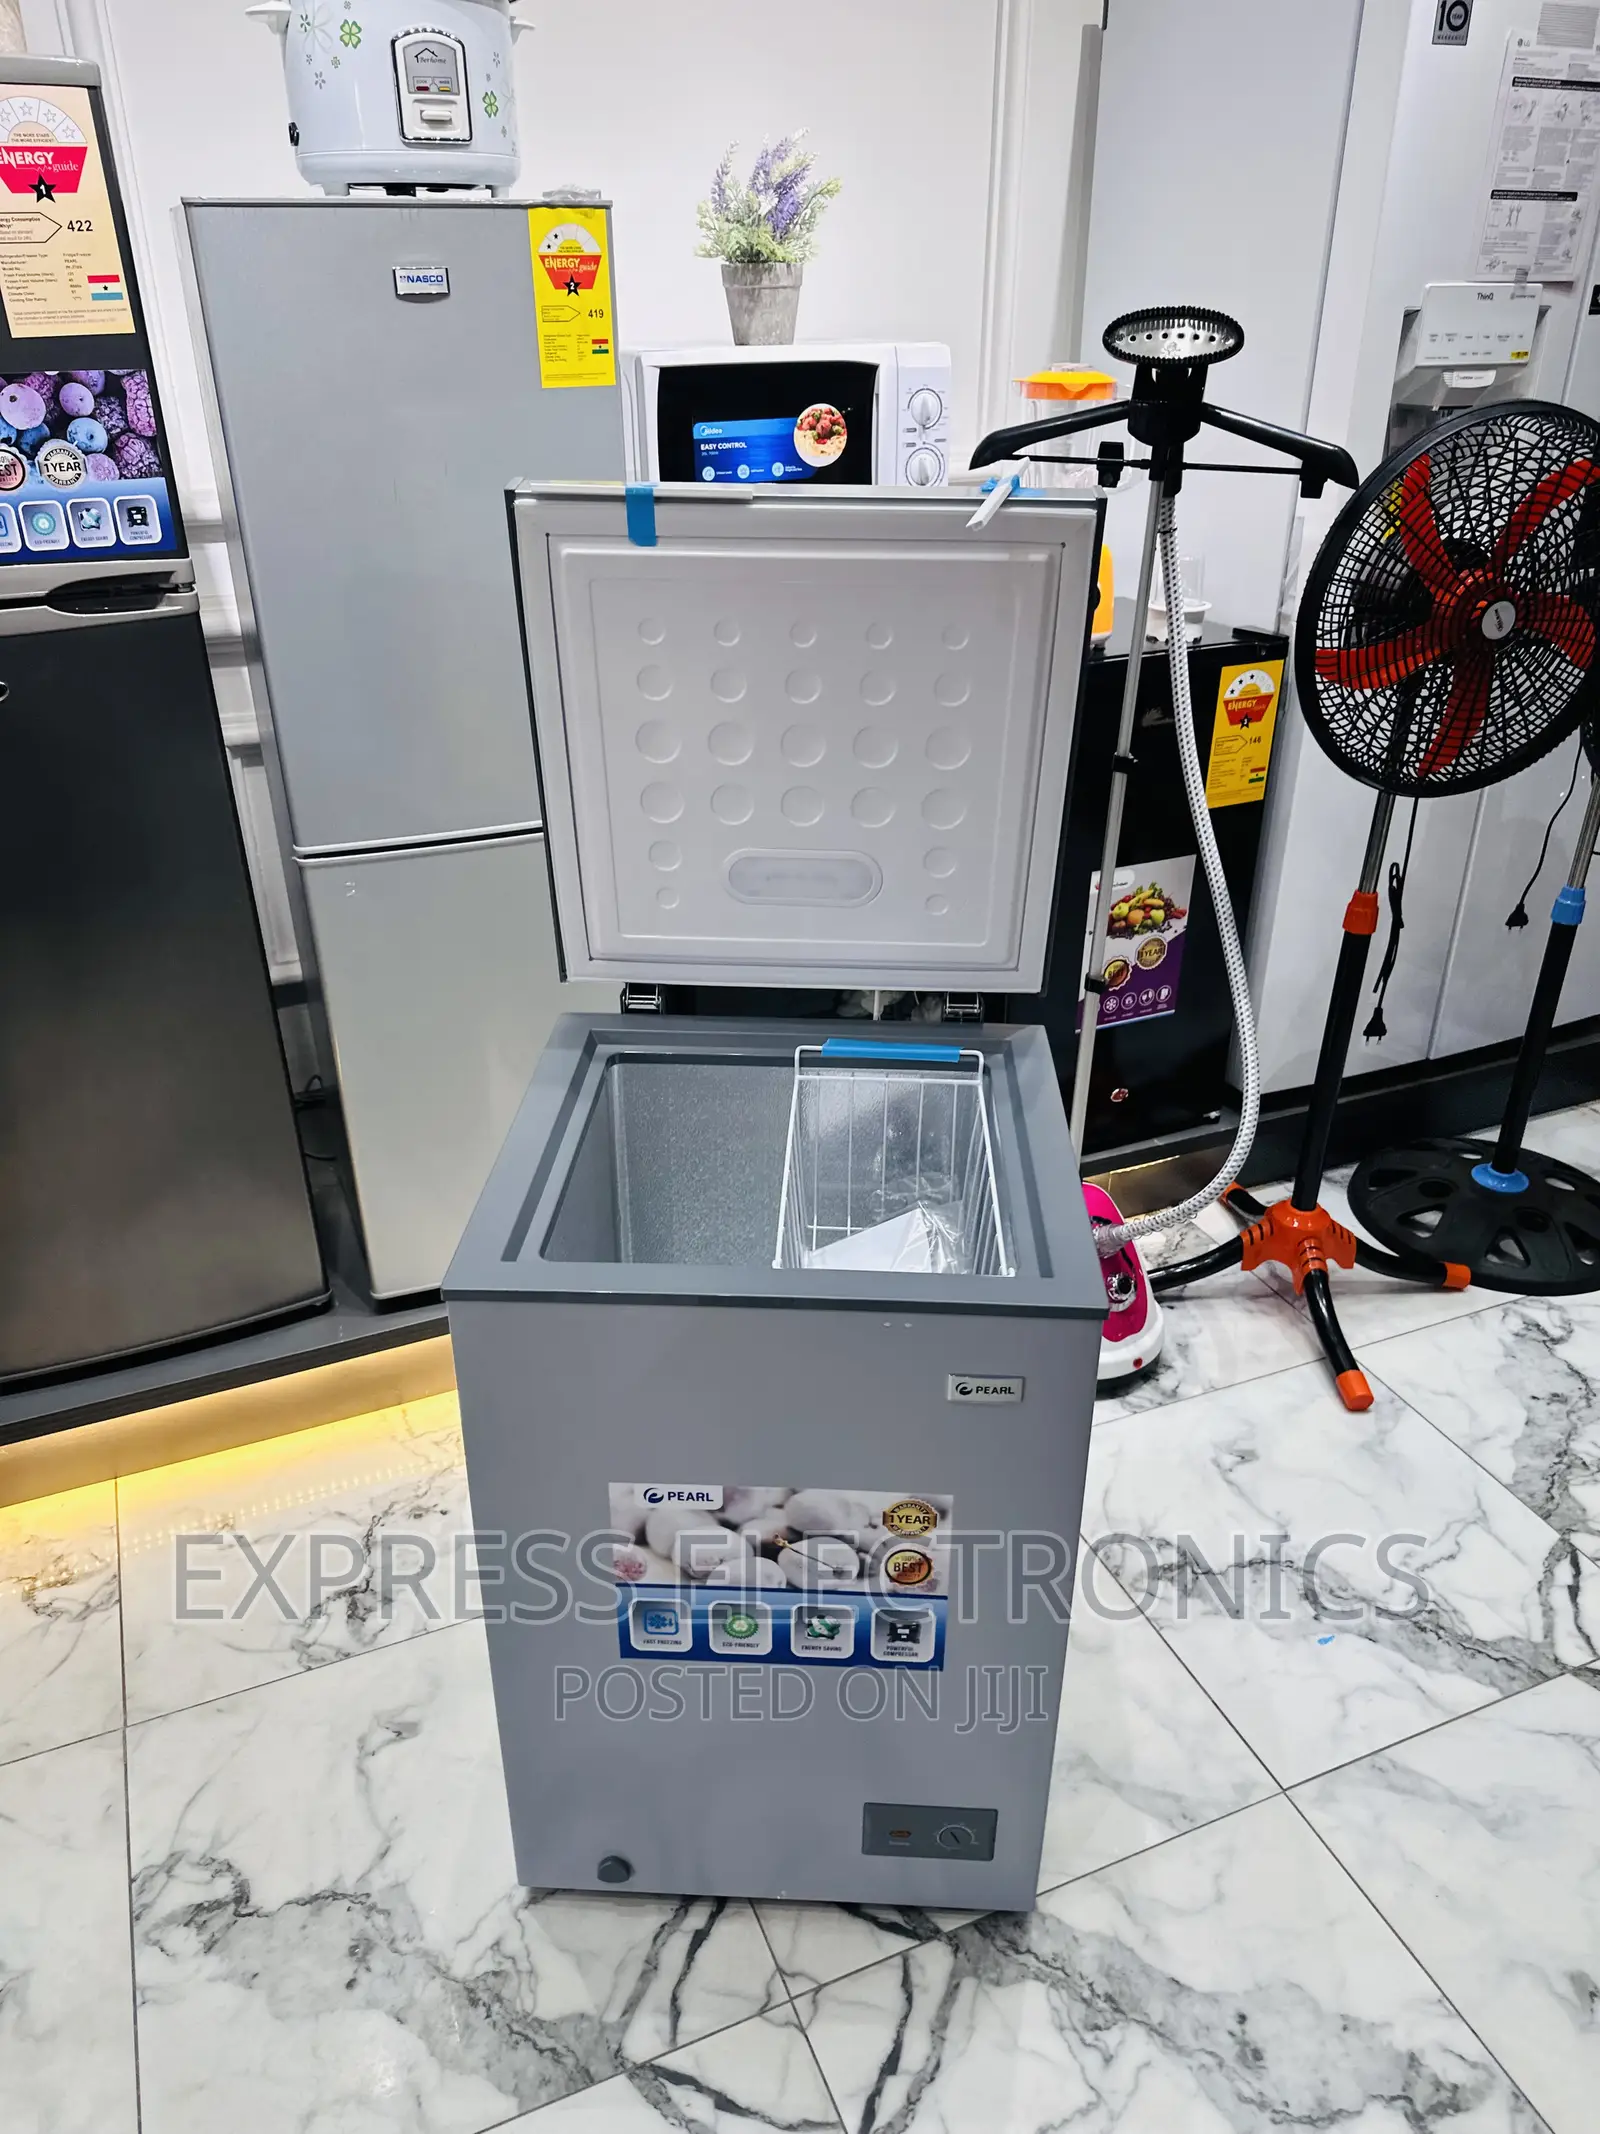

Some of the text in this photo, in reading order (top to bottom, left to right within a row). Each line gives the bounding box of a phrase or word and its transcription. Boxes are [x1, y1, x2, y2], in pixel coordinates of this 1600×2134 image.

[1438, 0, 1469, 32] 10
[52, 160, 79, 172] guide
[39, 184, 46, 195] 1
[67, 219, 94, 232] 422
[544, 256, 580, 272] ENERGY
[406, 275, 444, 283] NASCO
[569, 281, 575, 290] 2
[1476, 292, 1494, 301] ThinQ
[587, 308, 604, 319] 419
[700, 442, 747, 451] EASY CONTROL
[43, 461, 82, 473] 1 YEAR
[1227, 699, 1258, 711] ENERGY
[975, 1385, 1015, 1395] PEARL
[667, 1491, 714, 1502] PEARL
[893, 1502, 928, 1514] WARRANTY
[888, 1514, 931, 1525] 1 YEAR
[893, 1561, 923, 1573] BEST
